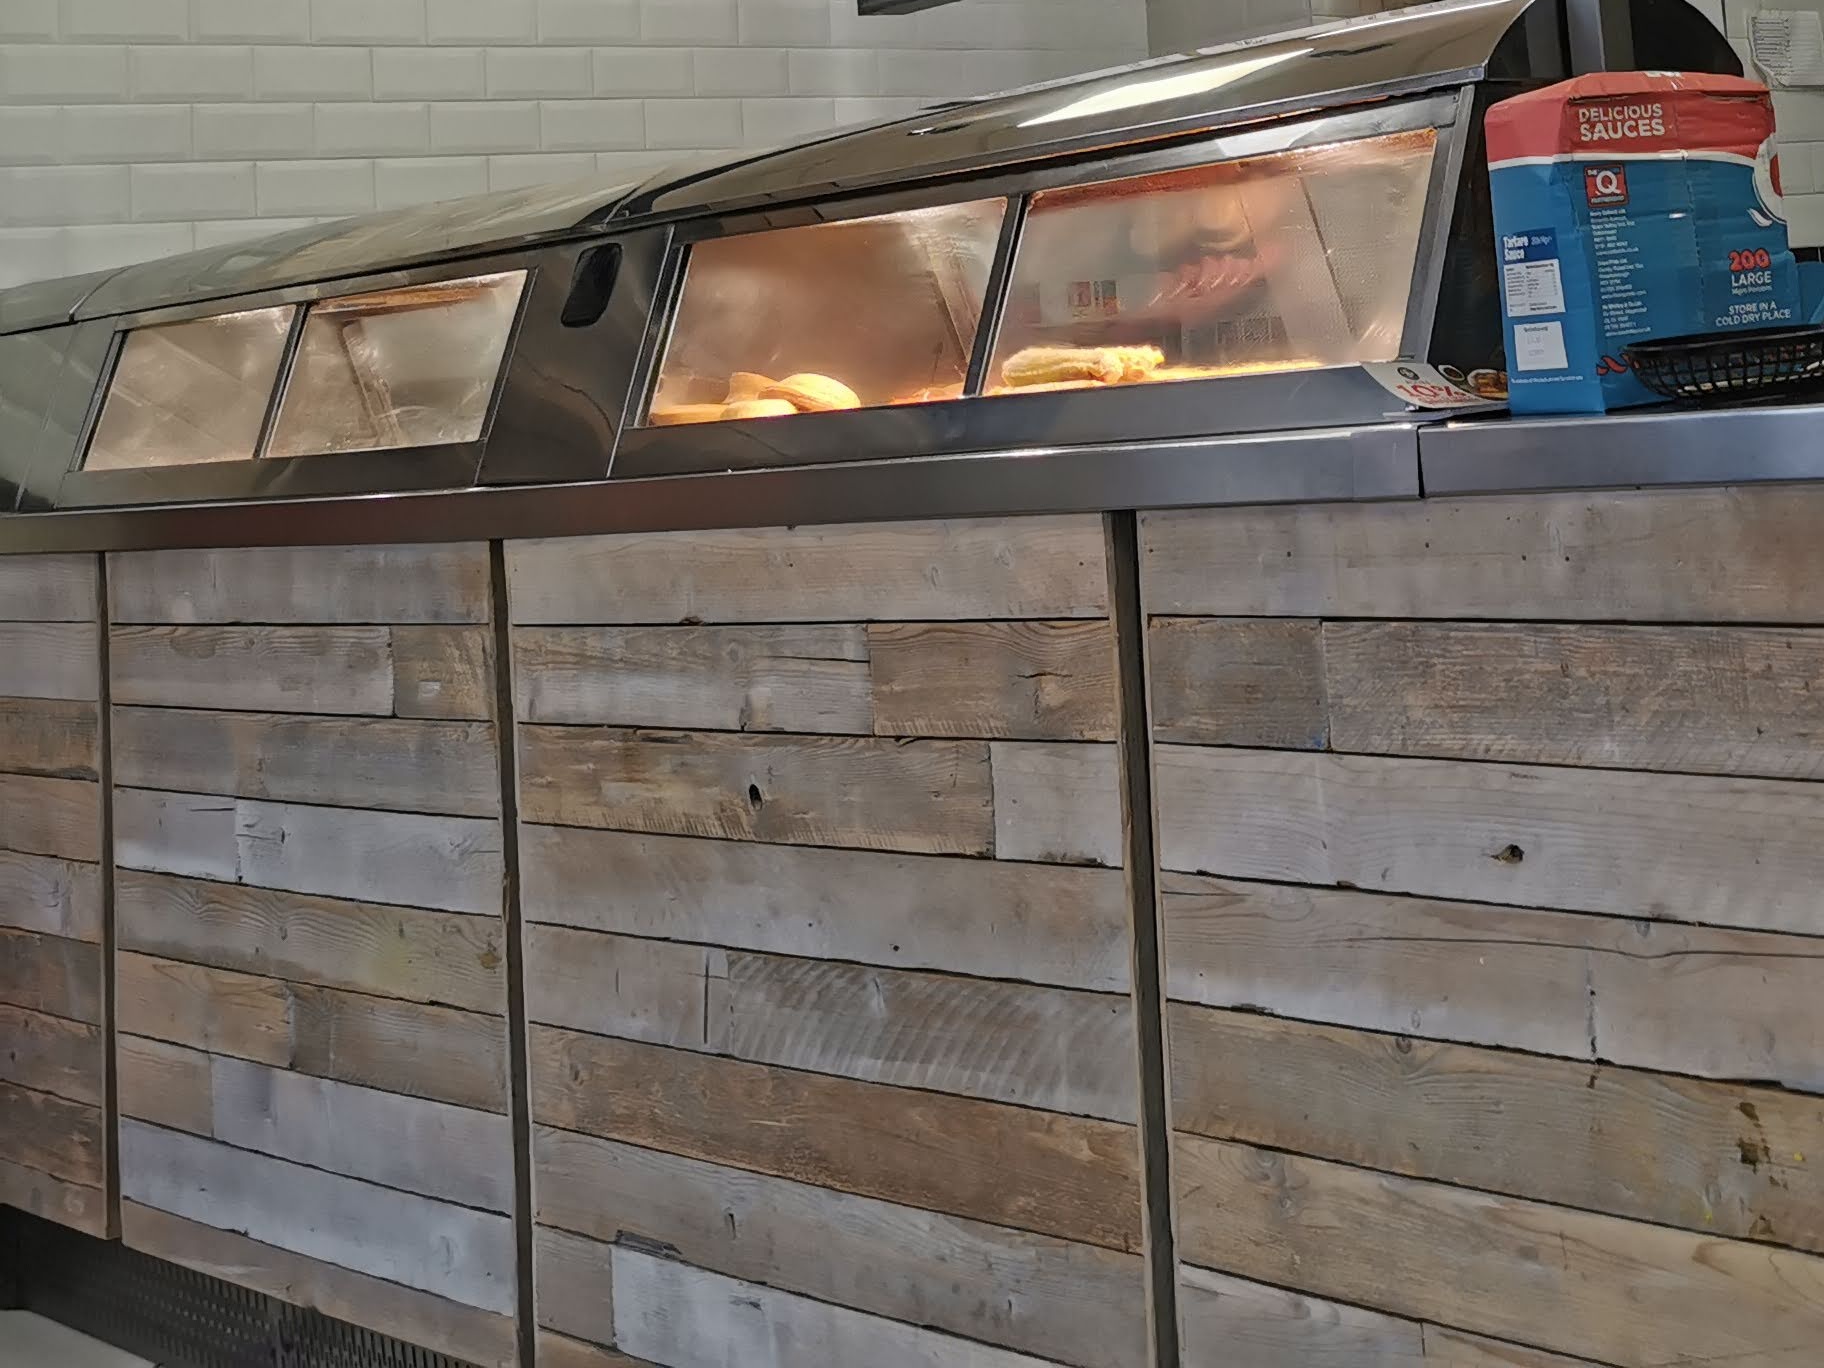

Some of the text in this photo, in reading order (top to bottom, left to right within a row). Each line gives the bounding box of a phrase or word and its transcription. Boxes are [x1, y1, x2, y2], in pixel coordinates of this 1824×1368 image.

[1578, 103, 1663, 123] DELICIOUS
[1580, 118, 1665, 142] SAUCES
[1728, 247, 1772, 272] 200
[1731, 270, 1773, 287] LARGE
[1728, 300, 1778, 315] STORE IN A
[1715, 308, 1792, 327] COLD DRY PLACE
